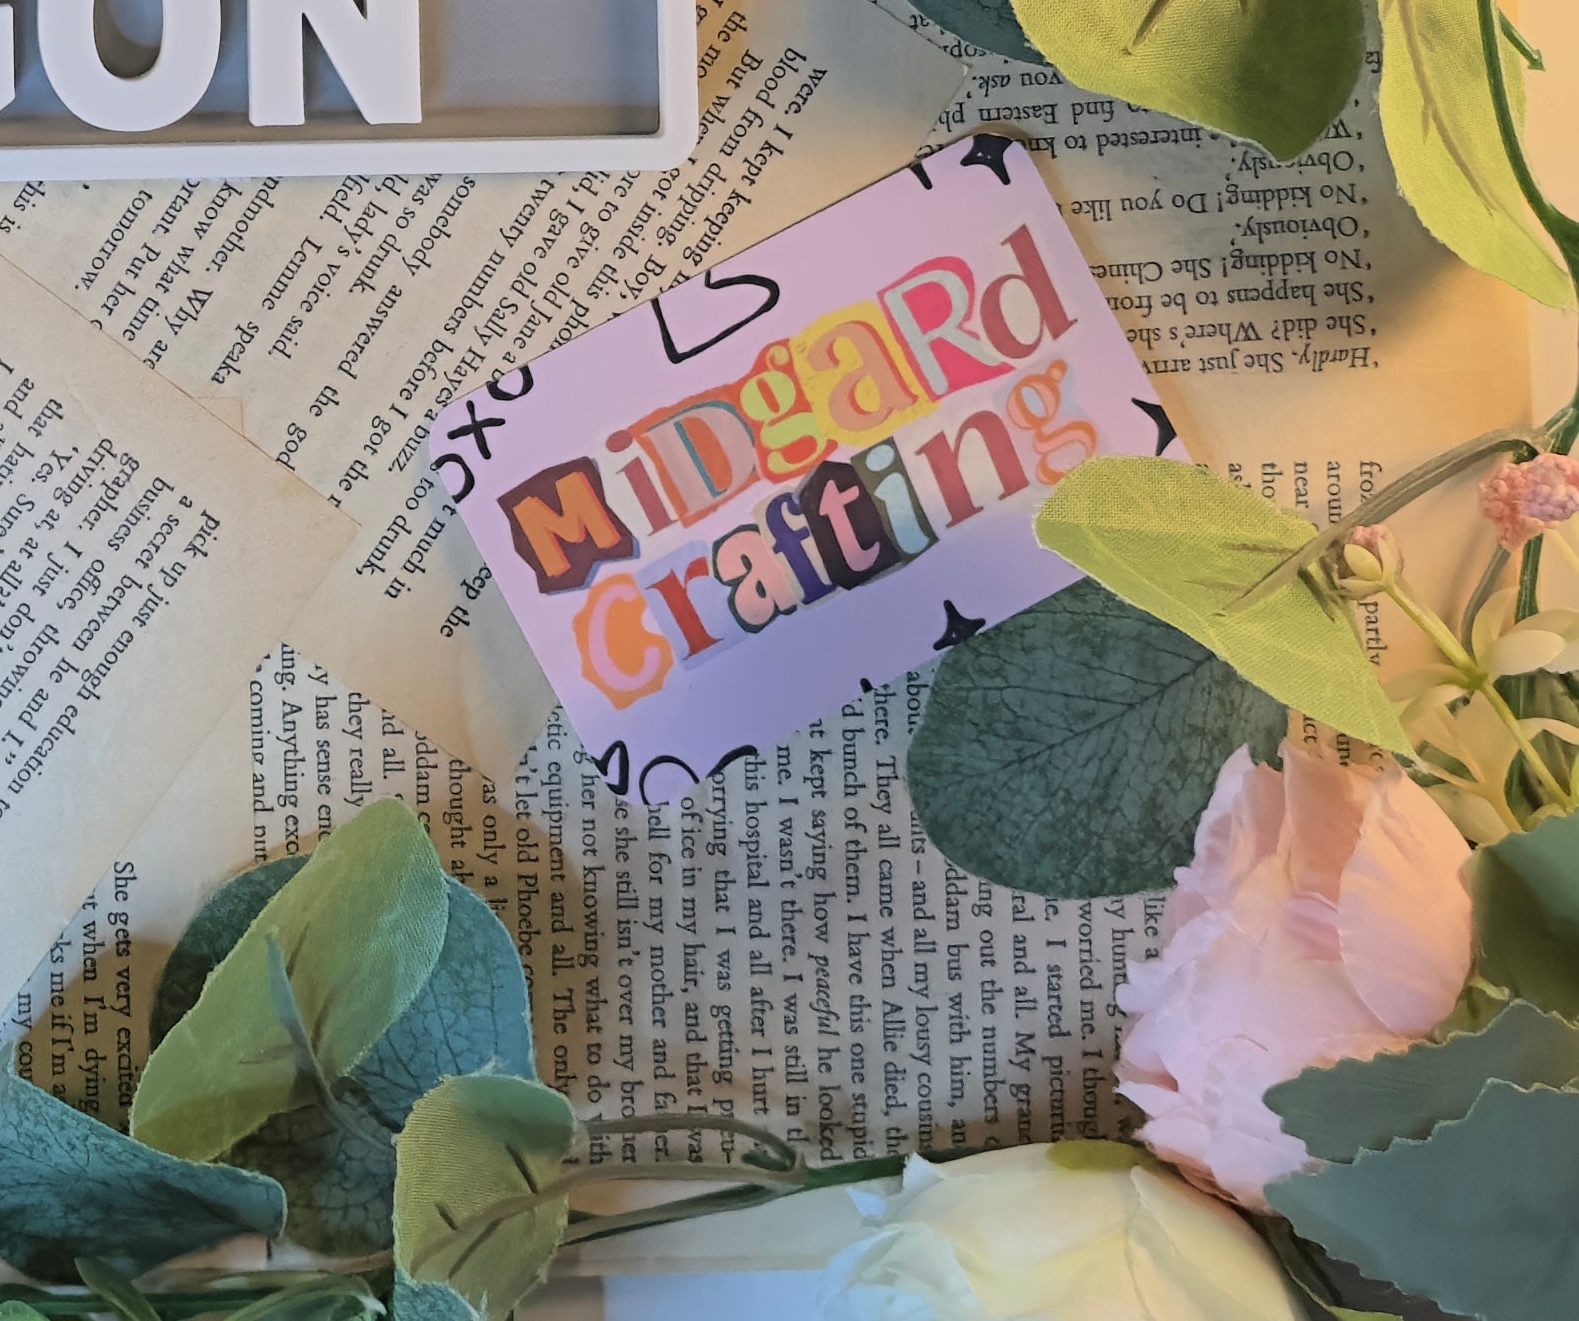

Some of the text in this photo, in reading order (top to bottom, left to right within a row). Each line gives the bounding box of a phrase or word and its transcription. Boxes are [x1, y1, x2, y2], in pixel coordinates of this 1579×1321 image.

[619, 47, 806, 300] blood from dripping. Boy,
[681, 68, 827, 267] were. I kept keeping
[74, 189, 152, 290] tomorrow.
[121, 178, 242, 341] know what time
[1170, 248, 1371, 280] 'No kidding! She
[1229, 215, 1369, 246] 'Obviously.'
[210, 235, 323, 384] Lemme speaka
[267, 200, 388, 359] lady's voice said.
[308, 175, 475, 417] somebody answered the
[1160, 278, 1374, 315] 'She happens to be
[1197, 342, 1378, 374] 'Hardly. She just
[106, 476, 174, 551] business
[582, 357, 1099, 690] Crafting
[1293, 461, 1313, 508] near
[157, 561, 186, 588] up
[182, 508, 220, 558] pick
[55, 558, 104, 610] office,
[131, 582, 169, 628] just
[75, 629, 133, 701] enough
[6, 703, 77, 794] education
[107, 861, 137, 1018] She gets very
[802, 748, 842, 1160] kept saying how peaceful he looked
[841, 727, 873, 1158] bunch of them. I have this one stupid
